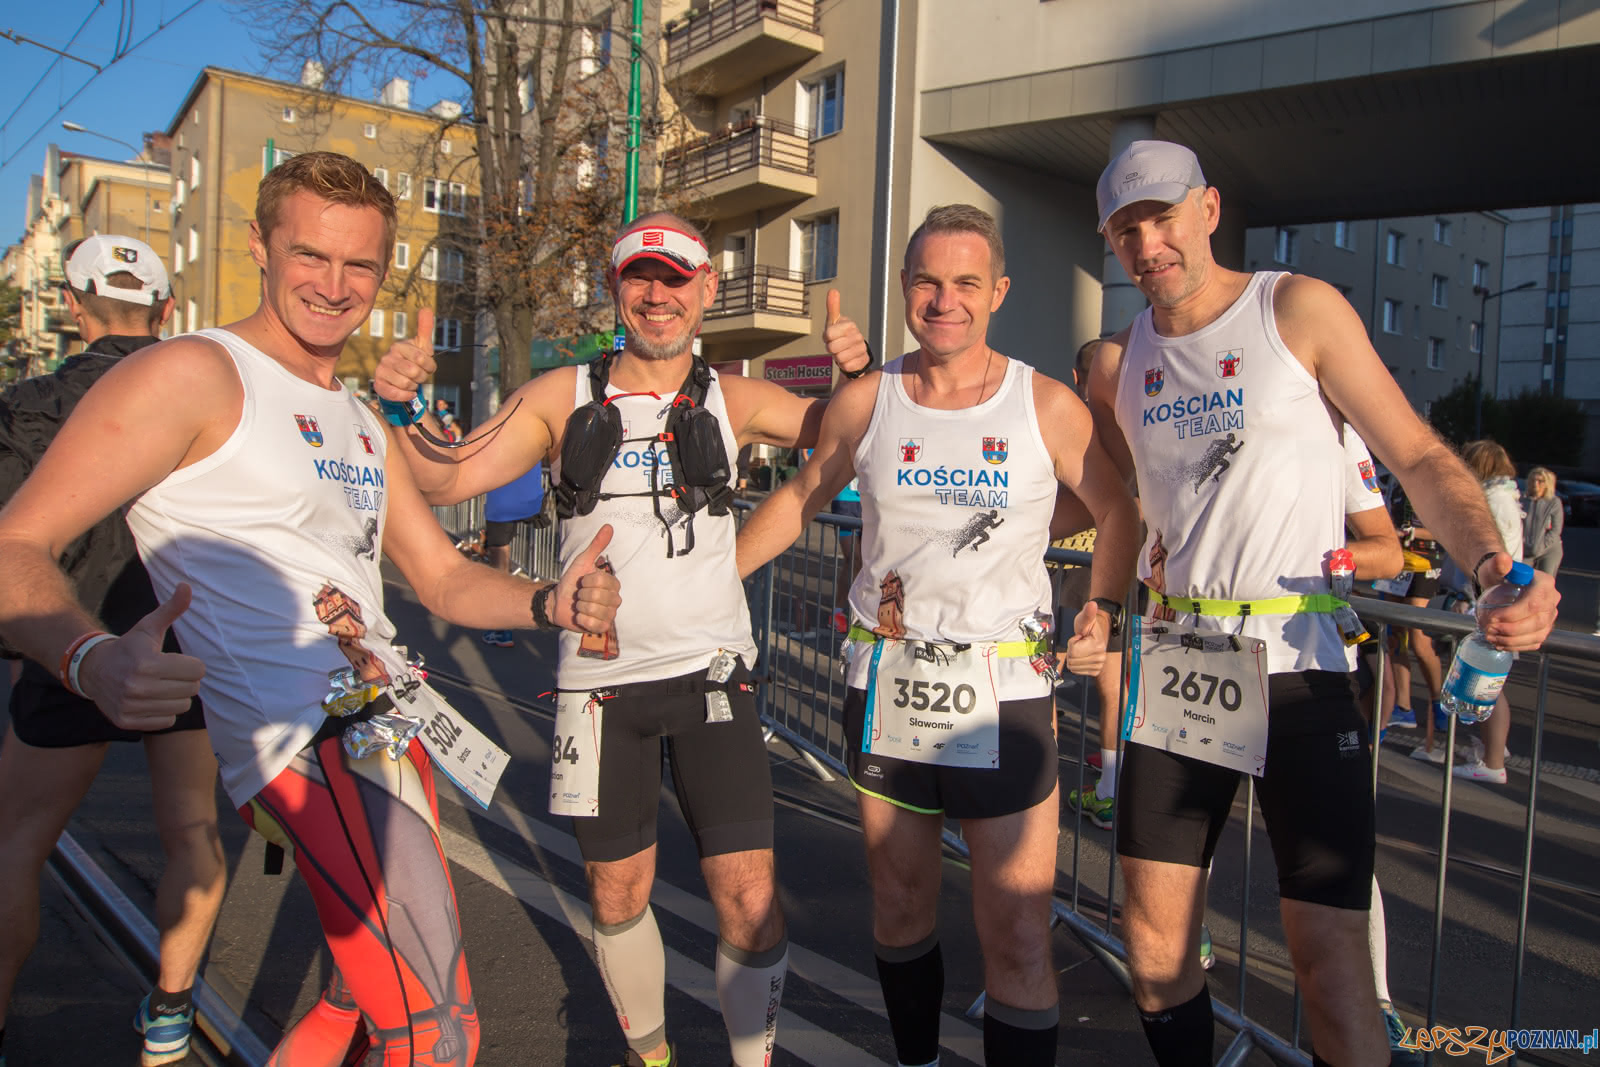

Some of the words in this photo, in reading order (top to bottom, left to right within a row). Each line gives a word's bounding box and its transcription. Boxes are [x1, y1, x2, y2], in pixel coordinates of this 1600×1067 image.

[766, 366, 795, 380] Steak
[797, 365, 832, 378] House
[1143, 387, 1243, 427] KOŚCIAN
[1174, 409, 1244, 439] TEAM
[313, 457, 384, 488] KOŚCIAN
[897, 465, 1008, 488] KOŚCIAN
[935, 488, 1008, 508] TEAM
[893, 677, 976, 715] 3520
[1161, 665, 1242, 712] 2670
[909, 717, 954, 731] Sławomir
[1183, 708, 1216, 726] Marcin
[552, 734, 579, 765] 84
